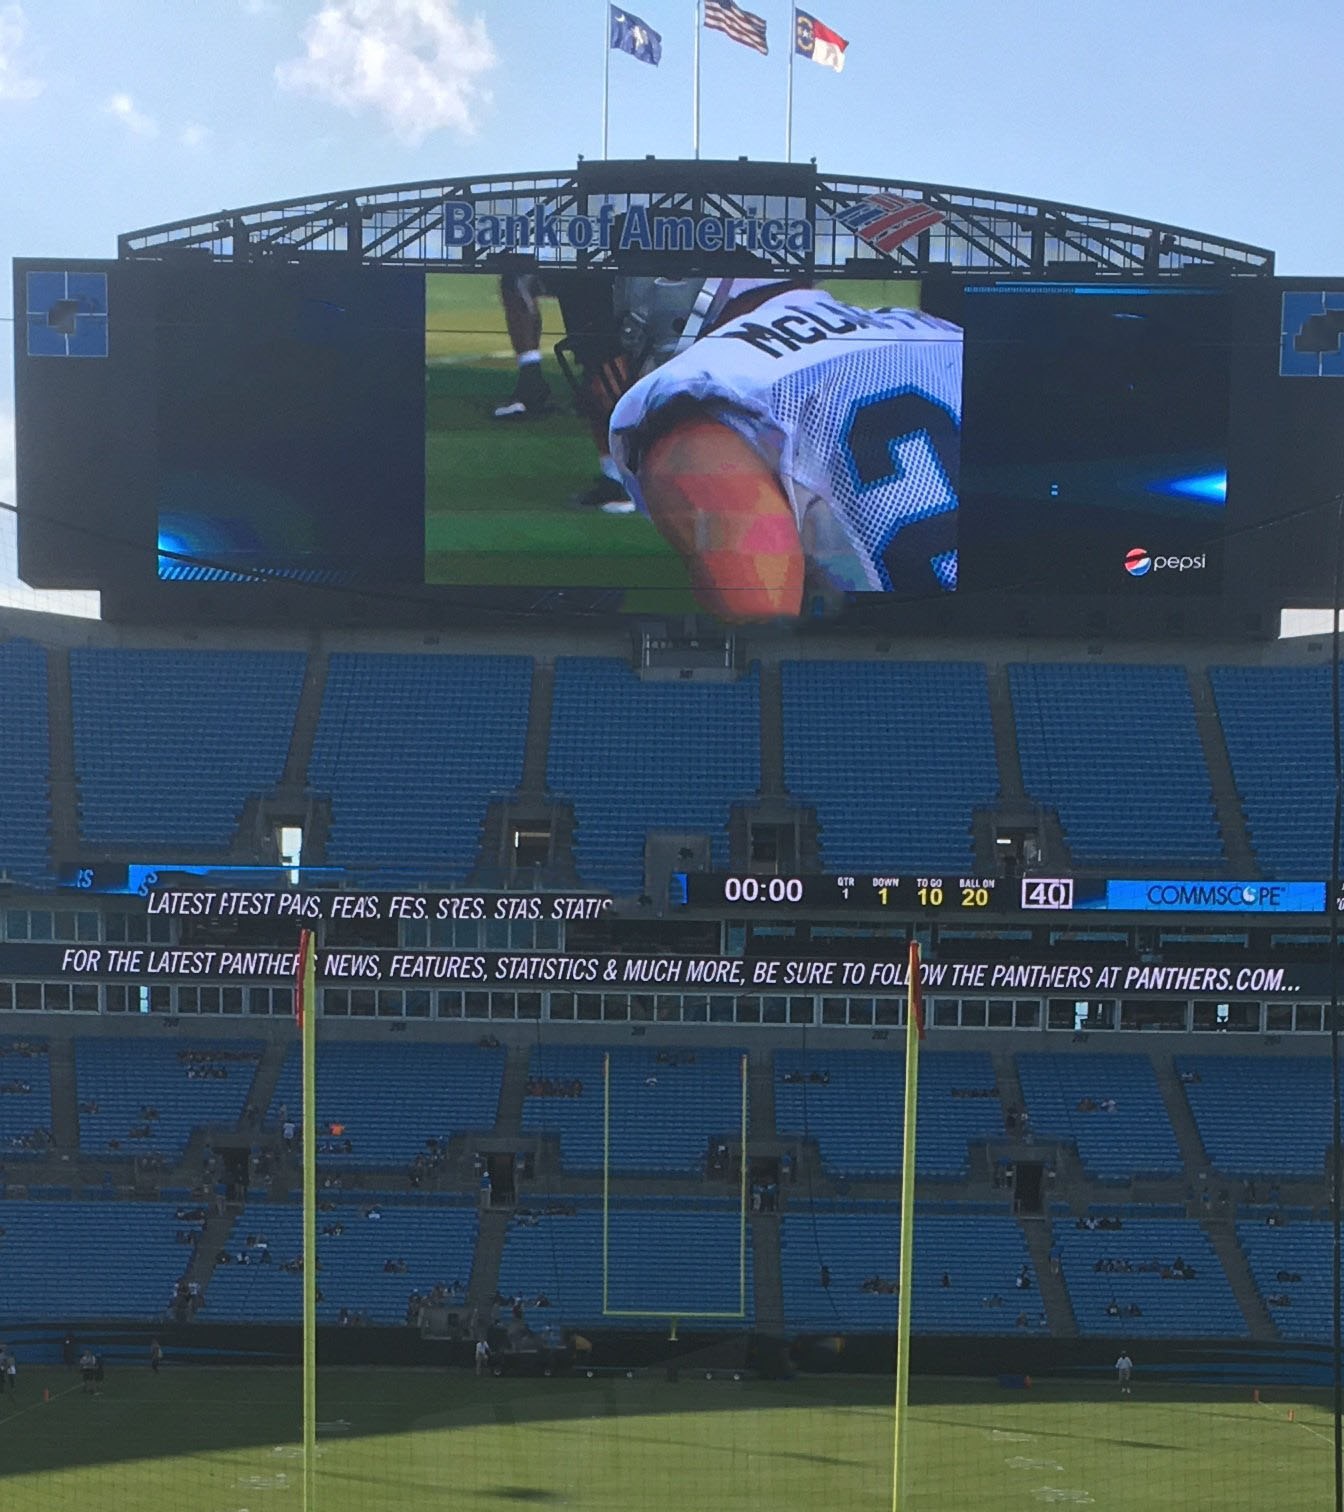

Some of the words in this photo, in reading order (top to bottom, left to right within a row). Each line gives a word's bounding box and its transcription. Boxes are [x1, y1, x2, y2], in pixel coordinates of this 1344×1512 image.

[442, 200, 558, 249] Bank
[567, 203, 615, 250] of
[619, 203, 814, 252] America
[1153, 553, 1207, 572] pepsi
[724, 877, 803, 902] 00:00
[872, 877, 899, 887] DOWN
[147, 892, 214, 914] LATEST
[842, 888, 850, 899] 1
[879, 888, 889, 905] 1
[917, 888, 944, 906] 10
[960, 888, 989, 907] 20
[1029, 883, 1065, 905] 40
[1147, 885, 1280, 906] COMMSCOPE
[62, 949, 101, 971] FOR
[107, 950, 140, 972] THE
[147, 952, 217, 973] LATEST
[324, 954, 382, 981] NEWS,
[389, 955, 489, 982] FEATURES,
[495, 957, 599, 981] STATISTICS
[602, 958, 618, 981] &
[623, 959, 682, 983] MUCH
[686, 960, 746, 986] MORE,
[753, 962, 780, 984] BE
[783, 962, 835, 985] SURE
[841, 962, 866, 985] TO
[950, 964, 987, 986] THE
[990, 964, 1093, 989] PANTHERS
[1096, 966, 1123, 988] AT
[1123, 966, 1301, 992] PANTHERS.COM...
